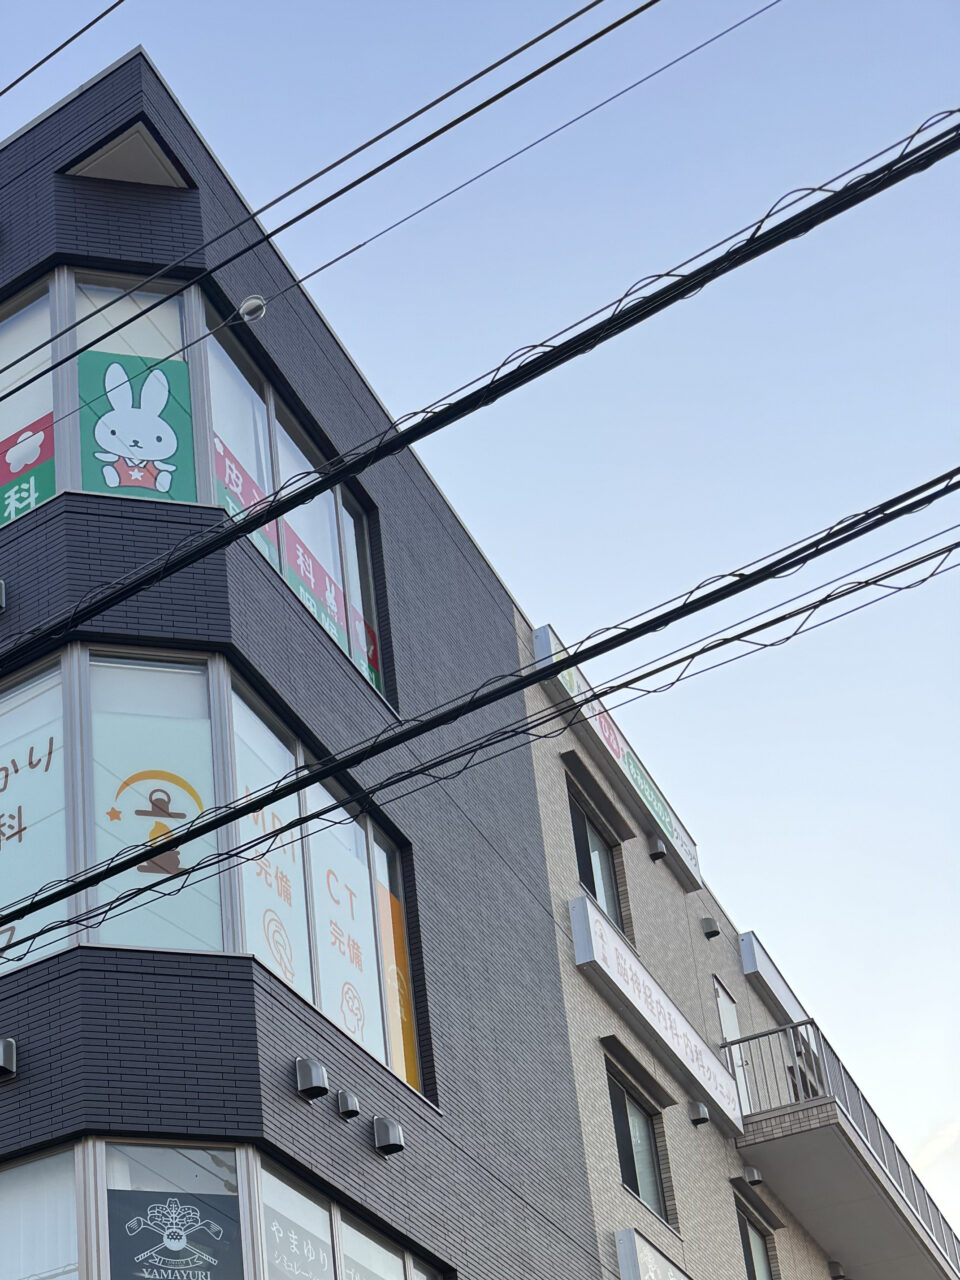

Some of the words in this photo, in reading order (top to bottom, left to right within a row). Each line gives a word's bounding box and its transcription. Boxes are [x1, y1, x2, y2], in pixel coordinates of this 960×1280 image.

[254, 848, 293, 907] 完備
[326, 868, 358, 921] CT
[328, 919, 363, 973] 完備
